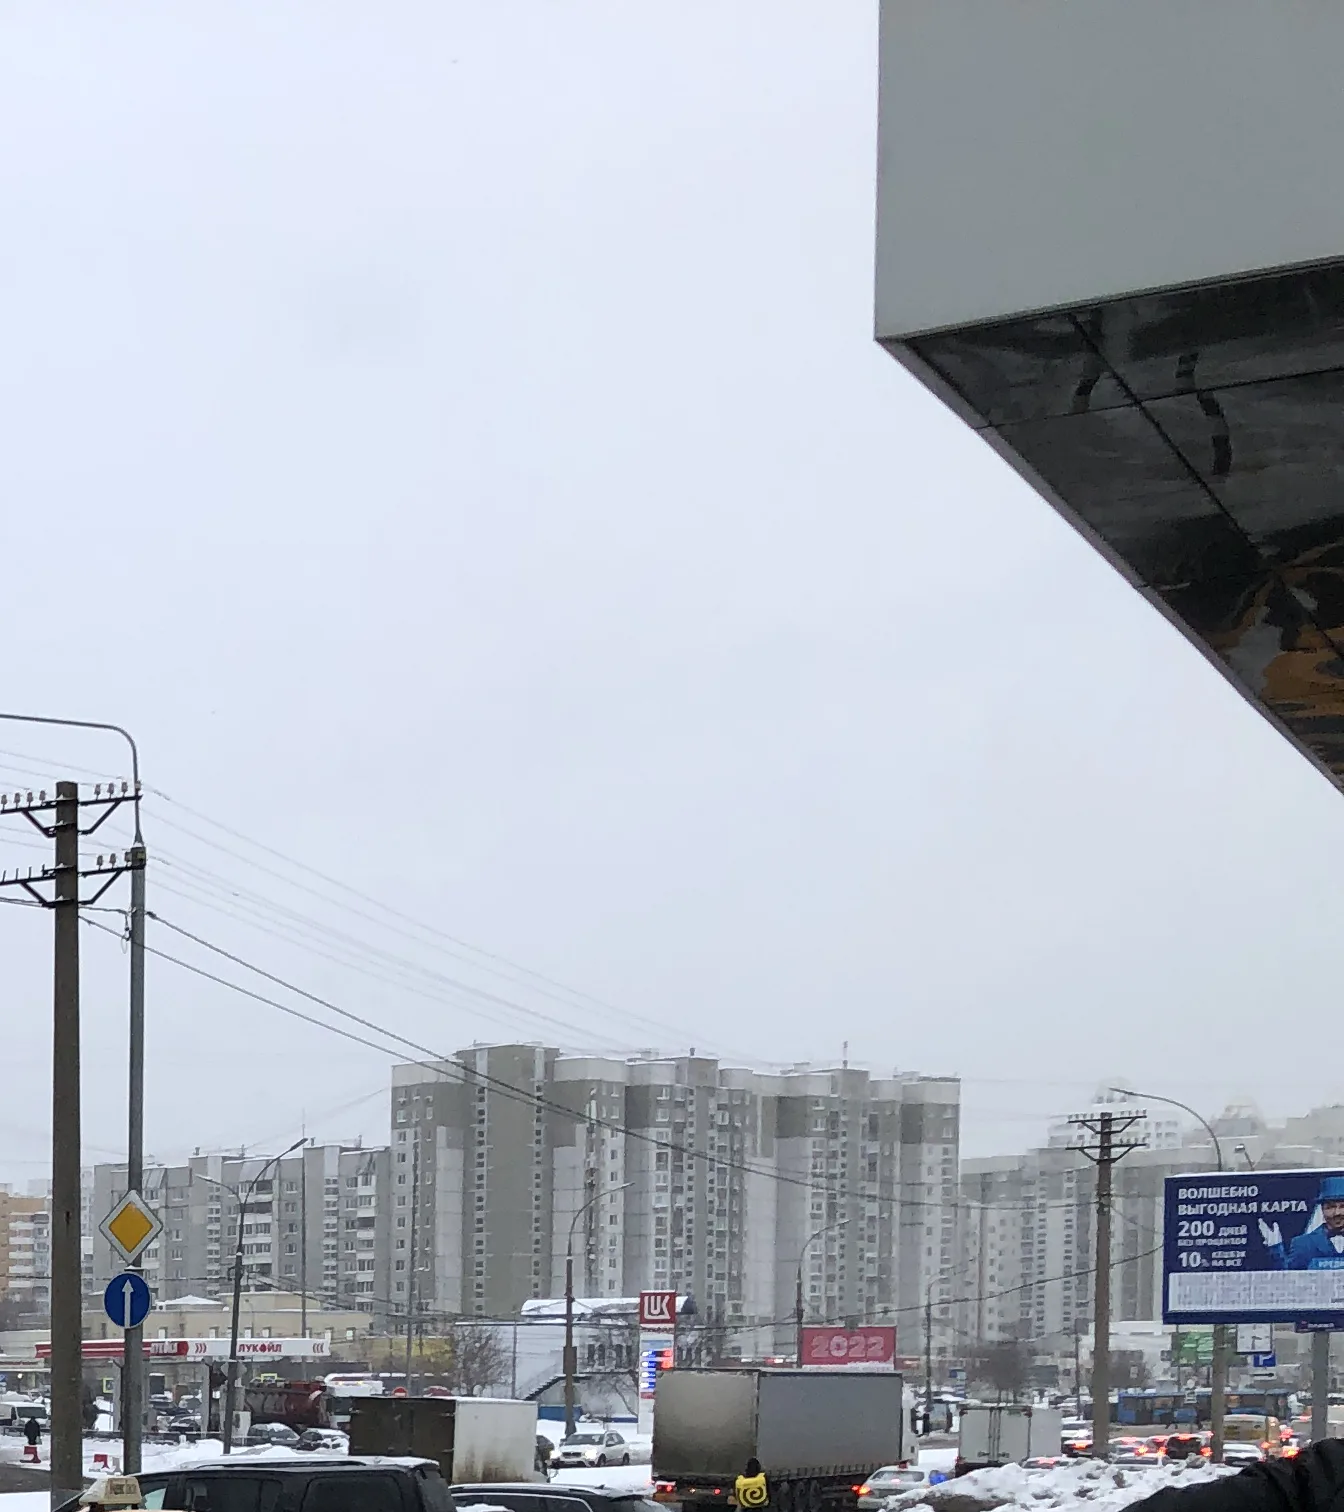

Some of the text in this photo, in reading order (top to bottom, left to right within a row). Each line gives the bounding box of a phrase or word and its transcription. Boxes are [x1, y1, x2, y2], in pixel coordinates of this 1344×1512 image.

[1177, 1185, 1259, 1200] ВОЛШЕБНО
[1177, 1200, 1308, 1217] ВЫГОДНАЯ КАРТА
[1178, 1220, 1248, 1237] 200 ДНЕЙ
[237, 1342, 282, 1353] ЛУКОЙЛ
[811, 1334, 885, 1358] 2022
